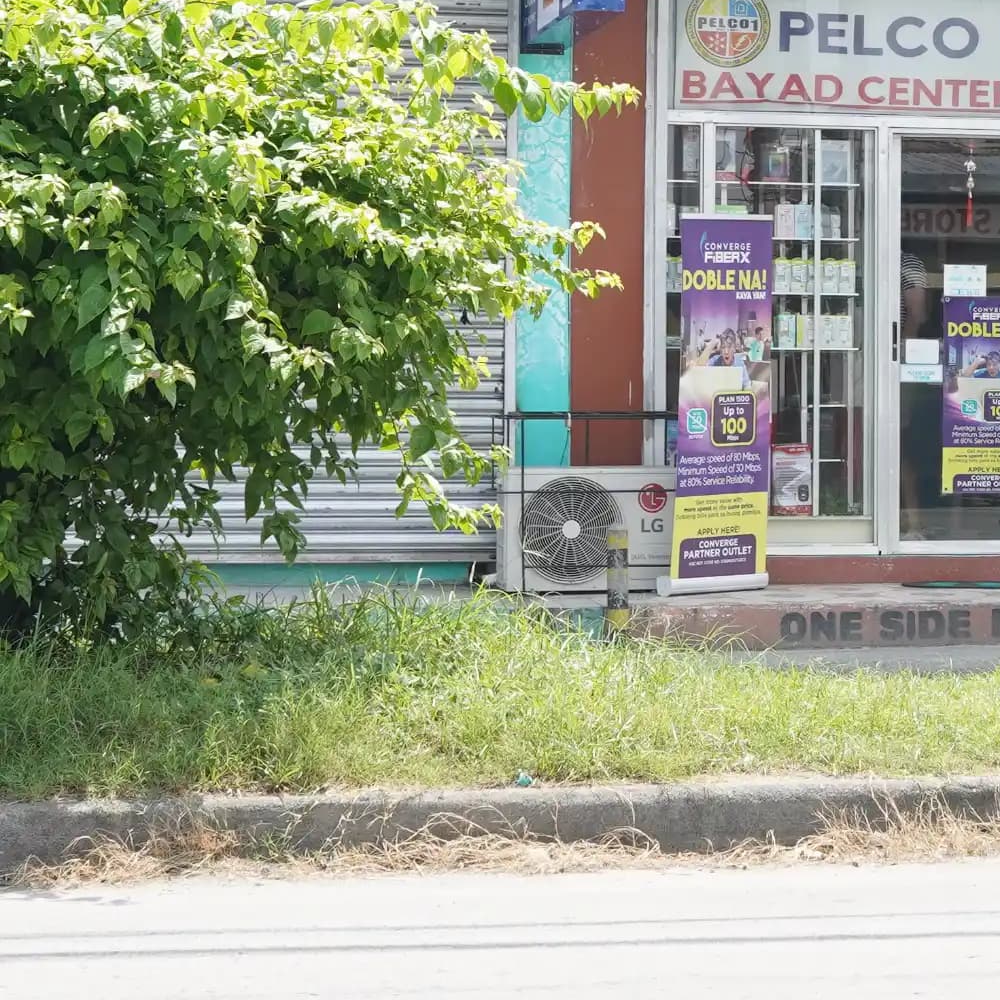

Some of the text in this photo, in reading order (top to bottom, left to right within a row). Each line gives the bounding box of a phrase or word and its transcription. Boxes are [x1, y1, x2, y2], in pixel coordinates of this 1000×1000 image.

[697, 16, 759, 31] PELCO1
[778, 10, 980, 59] PELCO
[681, 69, 844, 103] BAYAD
[704, 242, 751, 251] CONVERGE
[683, 269, 767, 290] DOBLE NA!
[947, 321, 1000, 337] DOBLE
[723, 406, 745, 417] Up to
[720, 417, 747, 435] 100
[679, 455, 706, 466] Average
[706, 454, 726, 465] speed
[677, 466, 707, 476] Minimum
[708, 465, 727, 476] Speed
[702, 476, 725, 486] Service
[957, 480, 992, 488] PARTNER
[641, 518, 664, 533] LG
[697, 527, 719, 536] APPLY
[698, 537, 739, 548] CONVERGE
[683, 545, 753, 560] PARTNER OUTLET
[780, 610, 863, 642] ONE
[879, 609, 971, 641] SIDE
